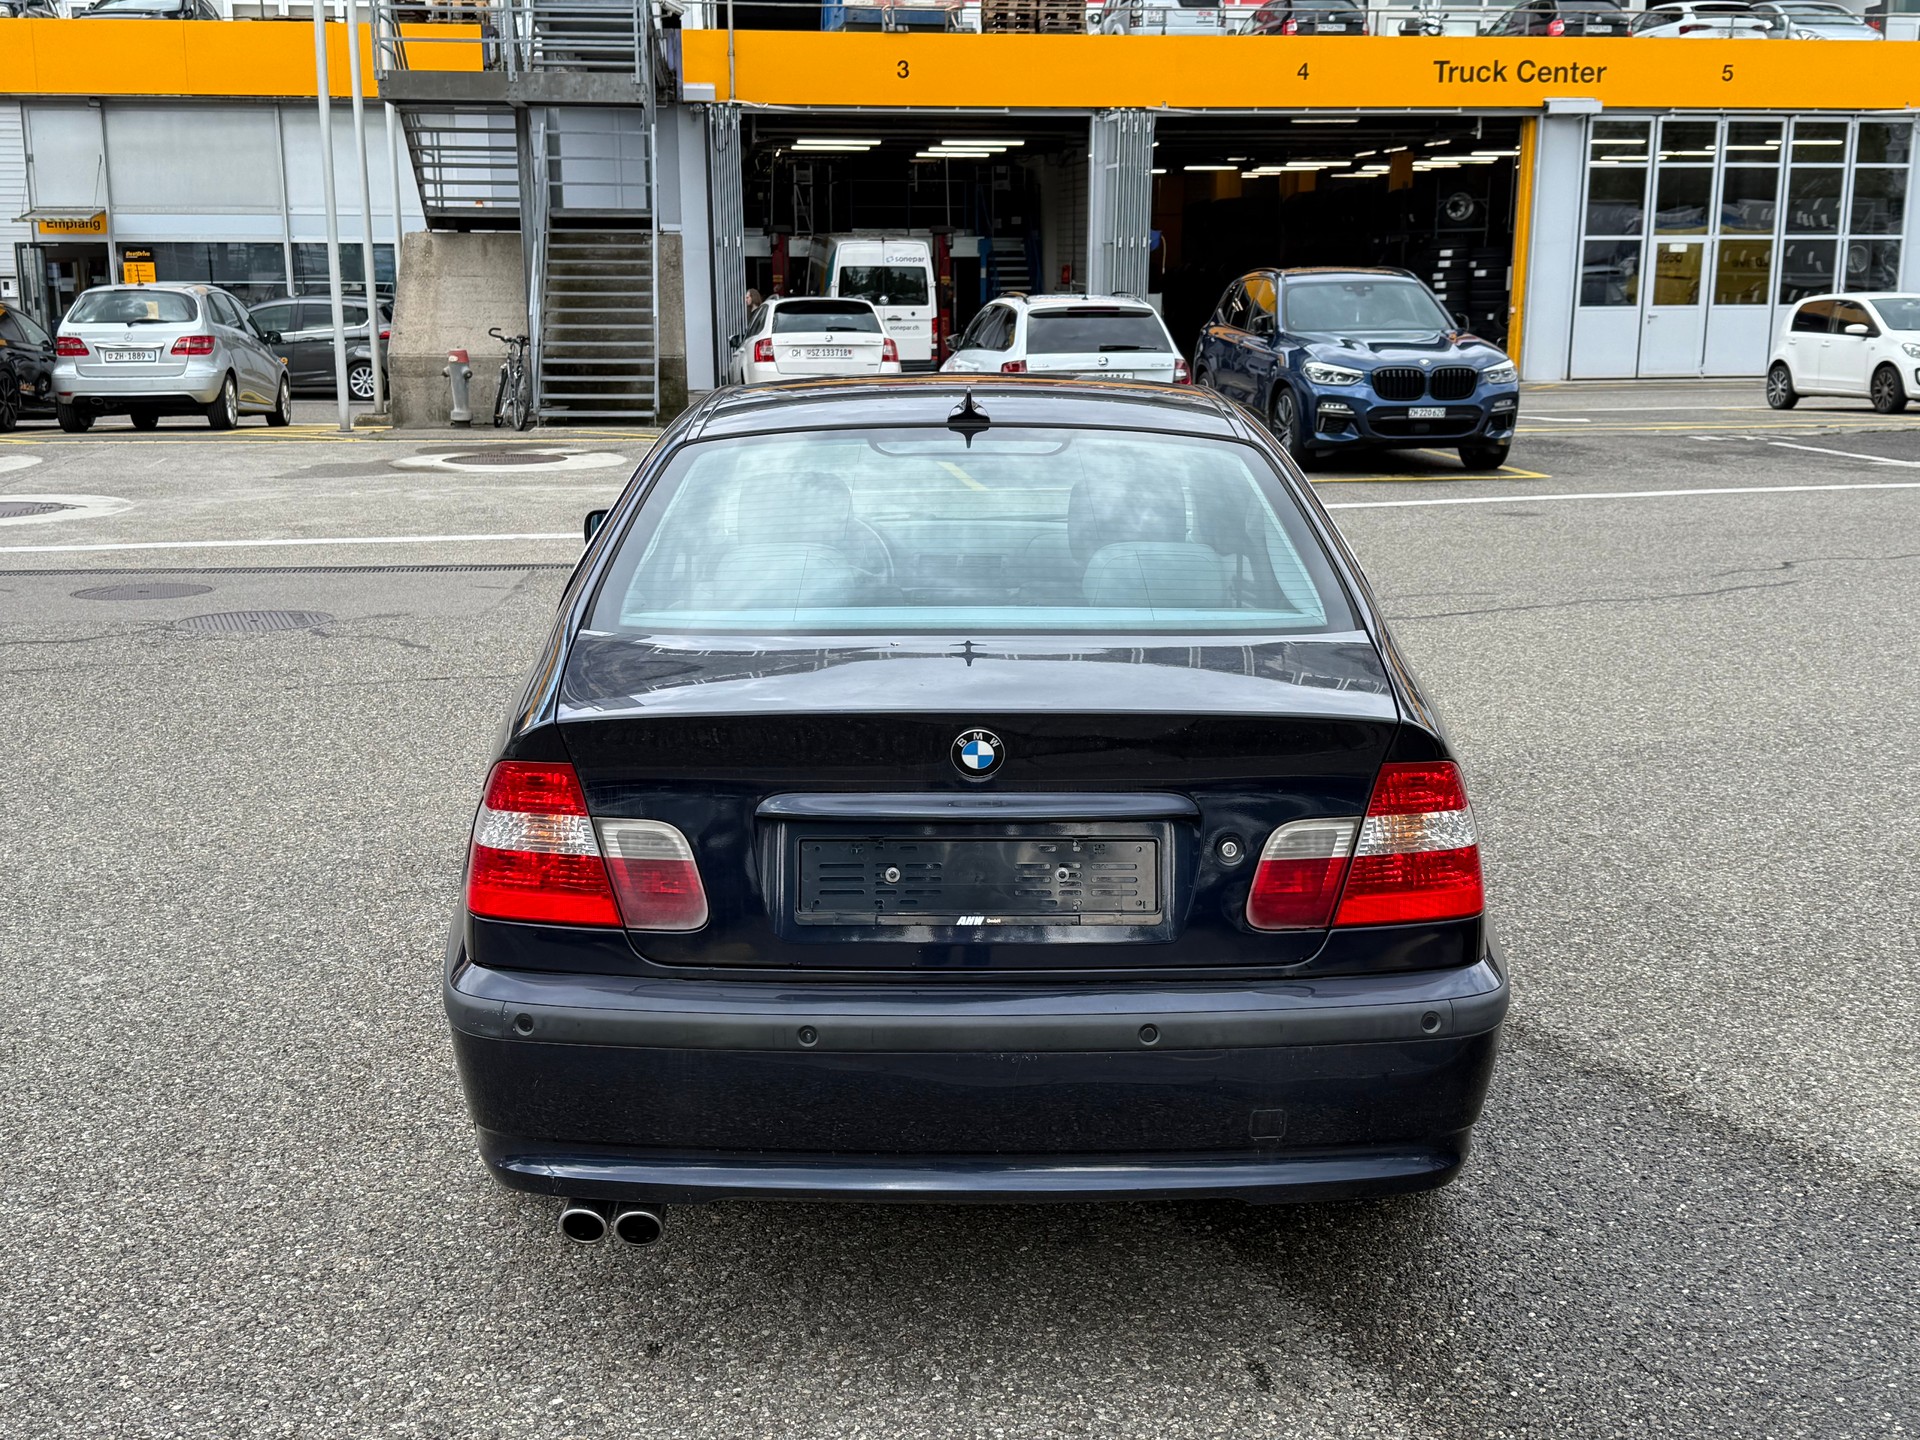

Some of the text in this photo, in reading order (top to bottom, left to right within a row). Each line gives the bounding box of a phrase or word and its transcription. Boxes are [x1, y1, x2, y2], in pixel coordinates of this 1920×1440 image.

[897, 60, 910, 79] 3
[1297, 62, 1310, 80] 4
[1433, 60, 1608, 83] Truck Center
[1721, 64, 1734, 82] 5
[791, 348, 801, 357] CH
[957, 732, 1000, 748] BMW
[956, 915, 985, 925] AHW
